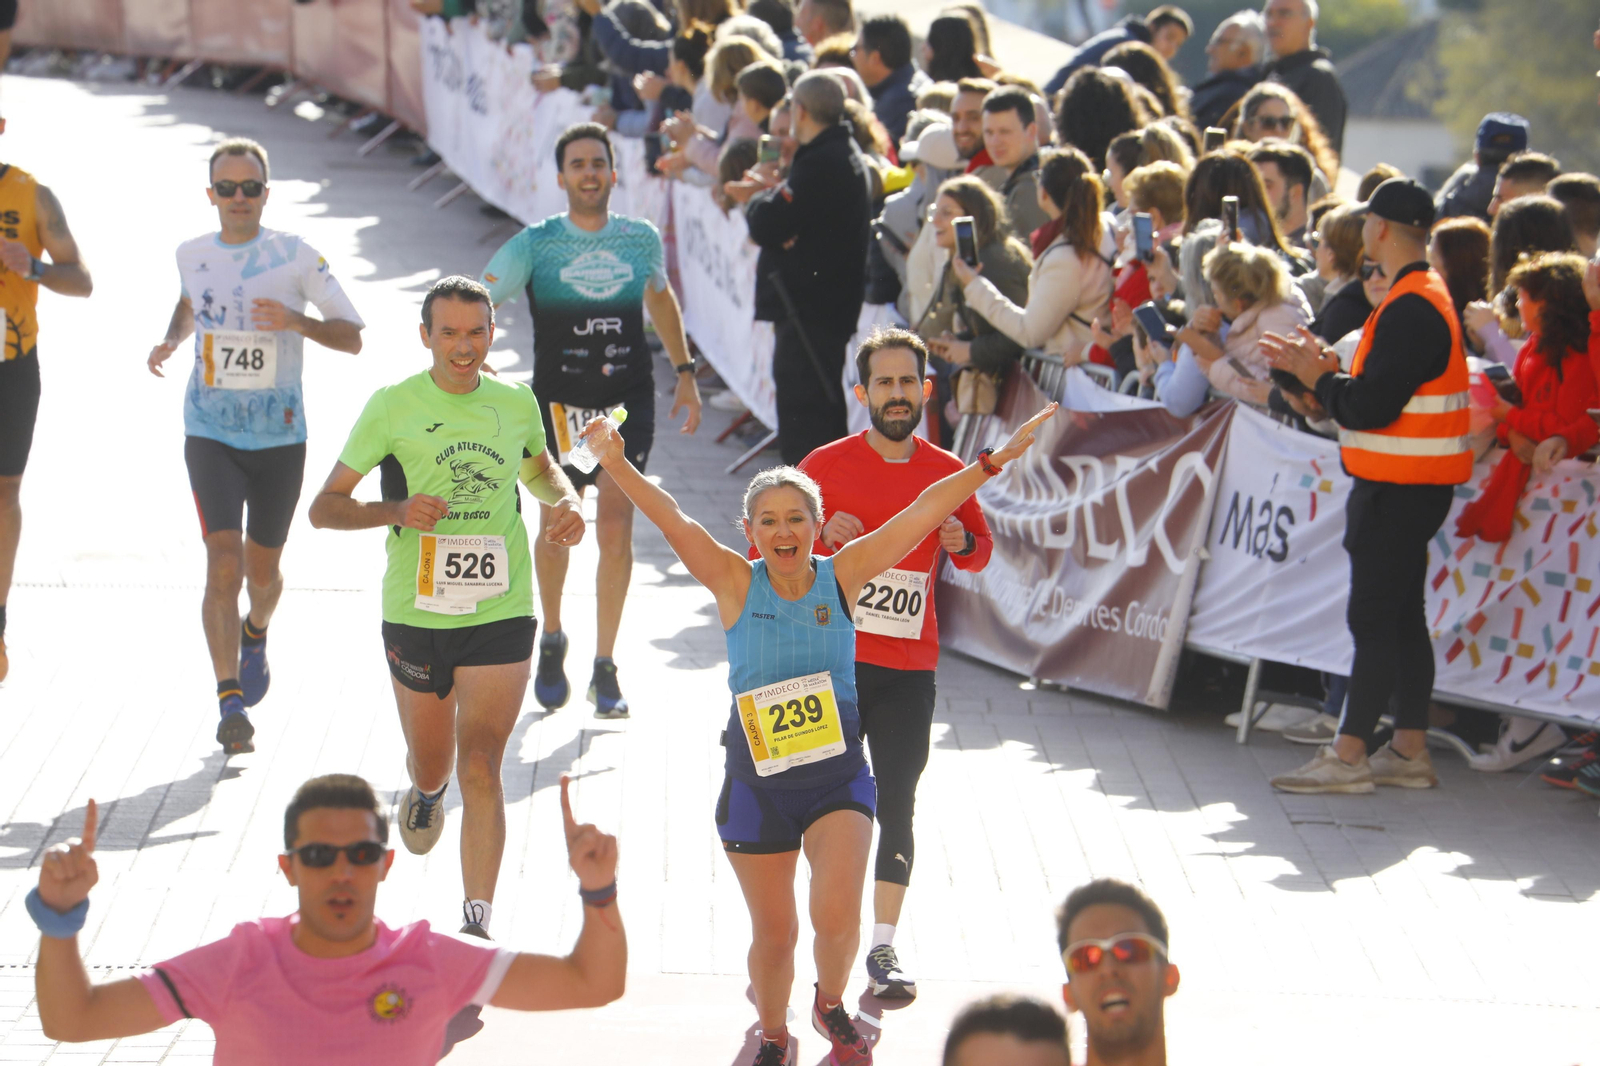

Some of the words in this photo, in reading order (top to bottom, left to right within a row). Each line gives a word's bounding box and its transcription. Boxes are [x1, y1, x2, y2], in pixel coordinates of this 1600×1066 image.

[221, 347, 264, 370] 748
[436, 445, 455, 465] CLUB
[457, 441, 505, 465] ATLETISMO
[463, 510, 490, 520] BOSCO
[447, 538, 482, 546] IMDECO
[422, 558, 431, 584] CAJÓN
[444, 552, 495, 580] 526
[856, 582, 922, 617] 2200
[865, 611, 880, 619] DANIEL
[881, 614, 900, 622] TABOADA
[763, 681, 800, 699] IMDECO
[768, 694, 824, 734] 239
[748, 719, 761, 747] CAJÓN
[795, 728, 815, 738] GUINDOS
[814, 724, 828, 732] LÓPEZ
